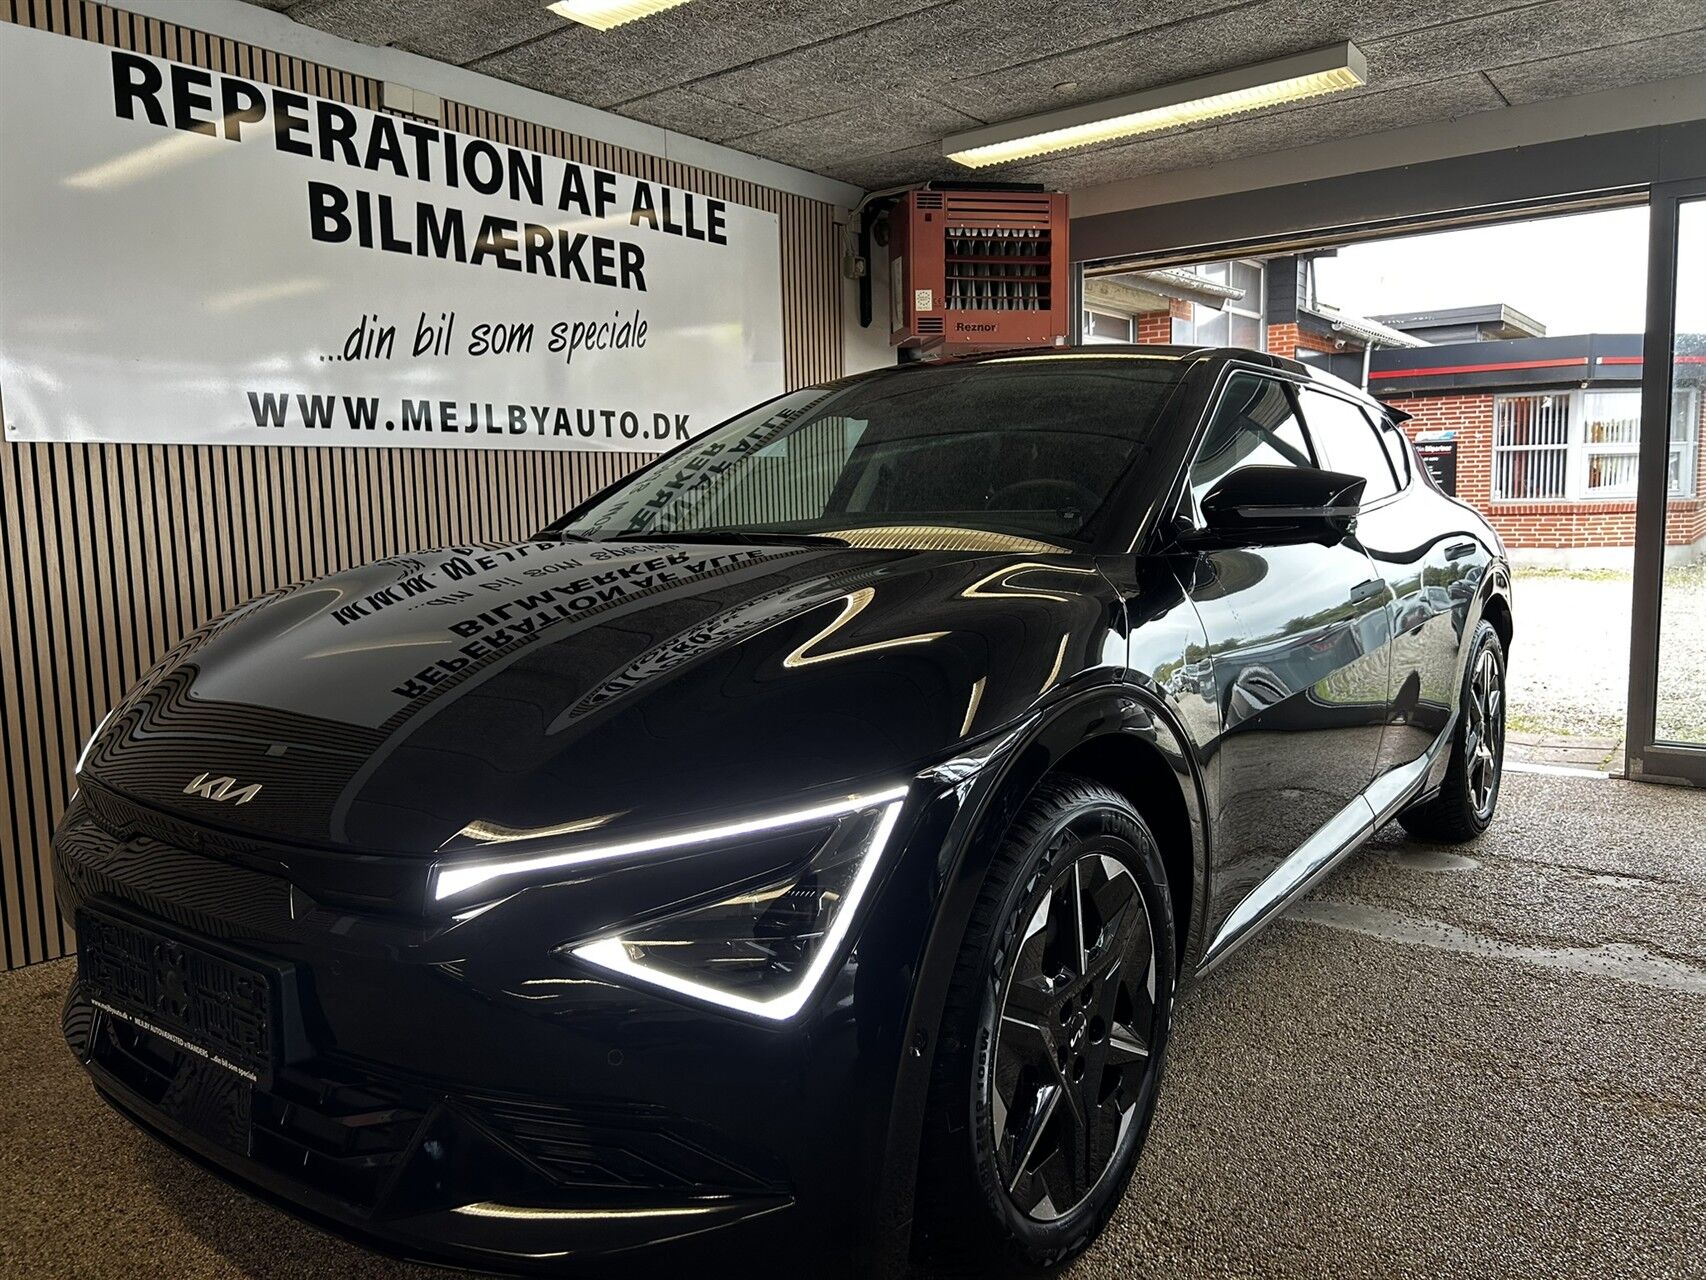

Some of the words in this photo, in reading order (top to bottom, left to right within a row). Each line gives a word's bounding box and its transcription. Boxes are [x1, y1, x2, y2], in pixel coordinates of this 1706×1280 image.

[110, 50, 544, 207] REPERATION
[557, 164, 618, 220] AF
[630, 181, 728, 246] ALLE
[308, 181, 648, 292] BILMÆRKER
[319, 314, 395, 363] ...din
[411, 311, 454, 358] bil
[469, 326, 533, 356] som
[548, 309, 648, 364] speciale
[956, 322, 996, 332] Reznor
[247, 391, 691, 441] WWW.MEJLBYAUTO.DK
[183, 772, 263, 806] KIA
